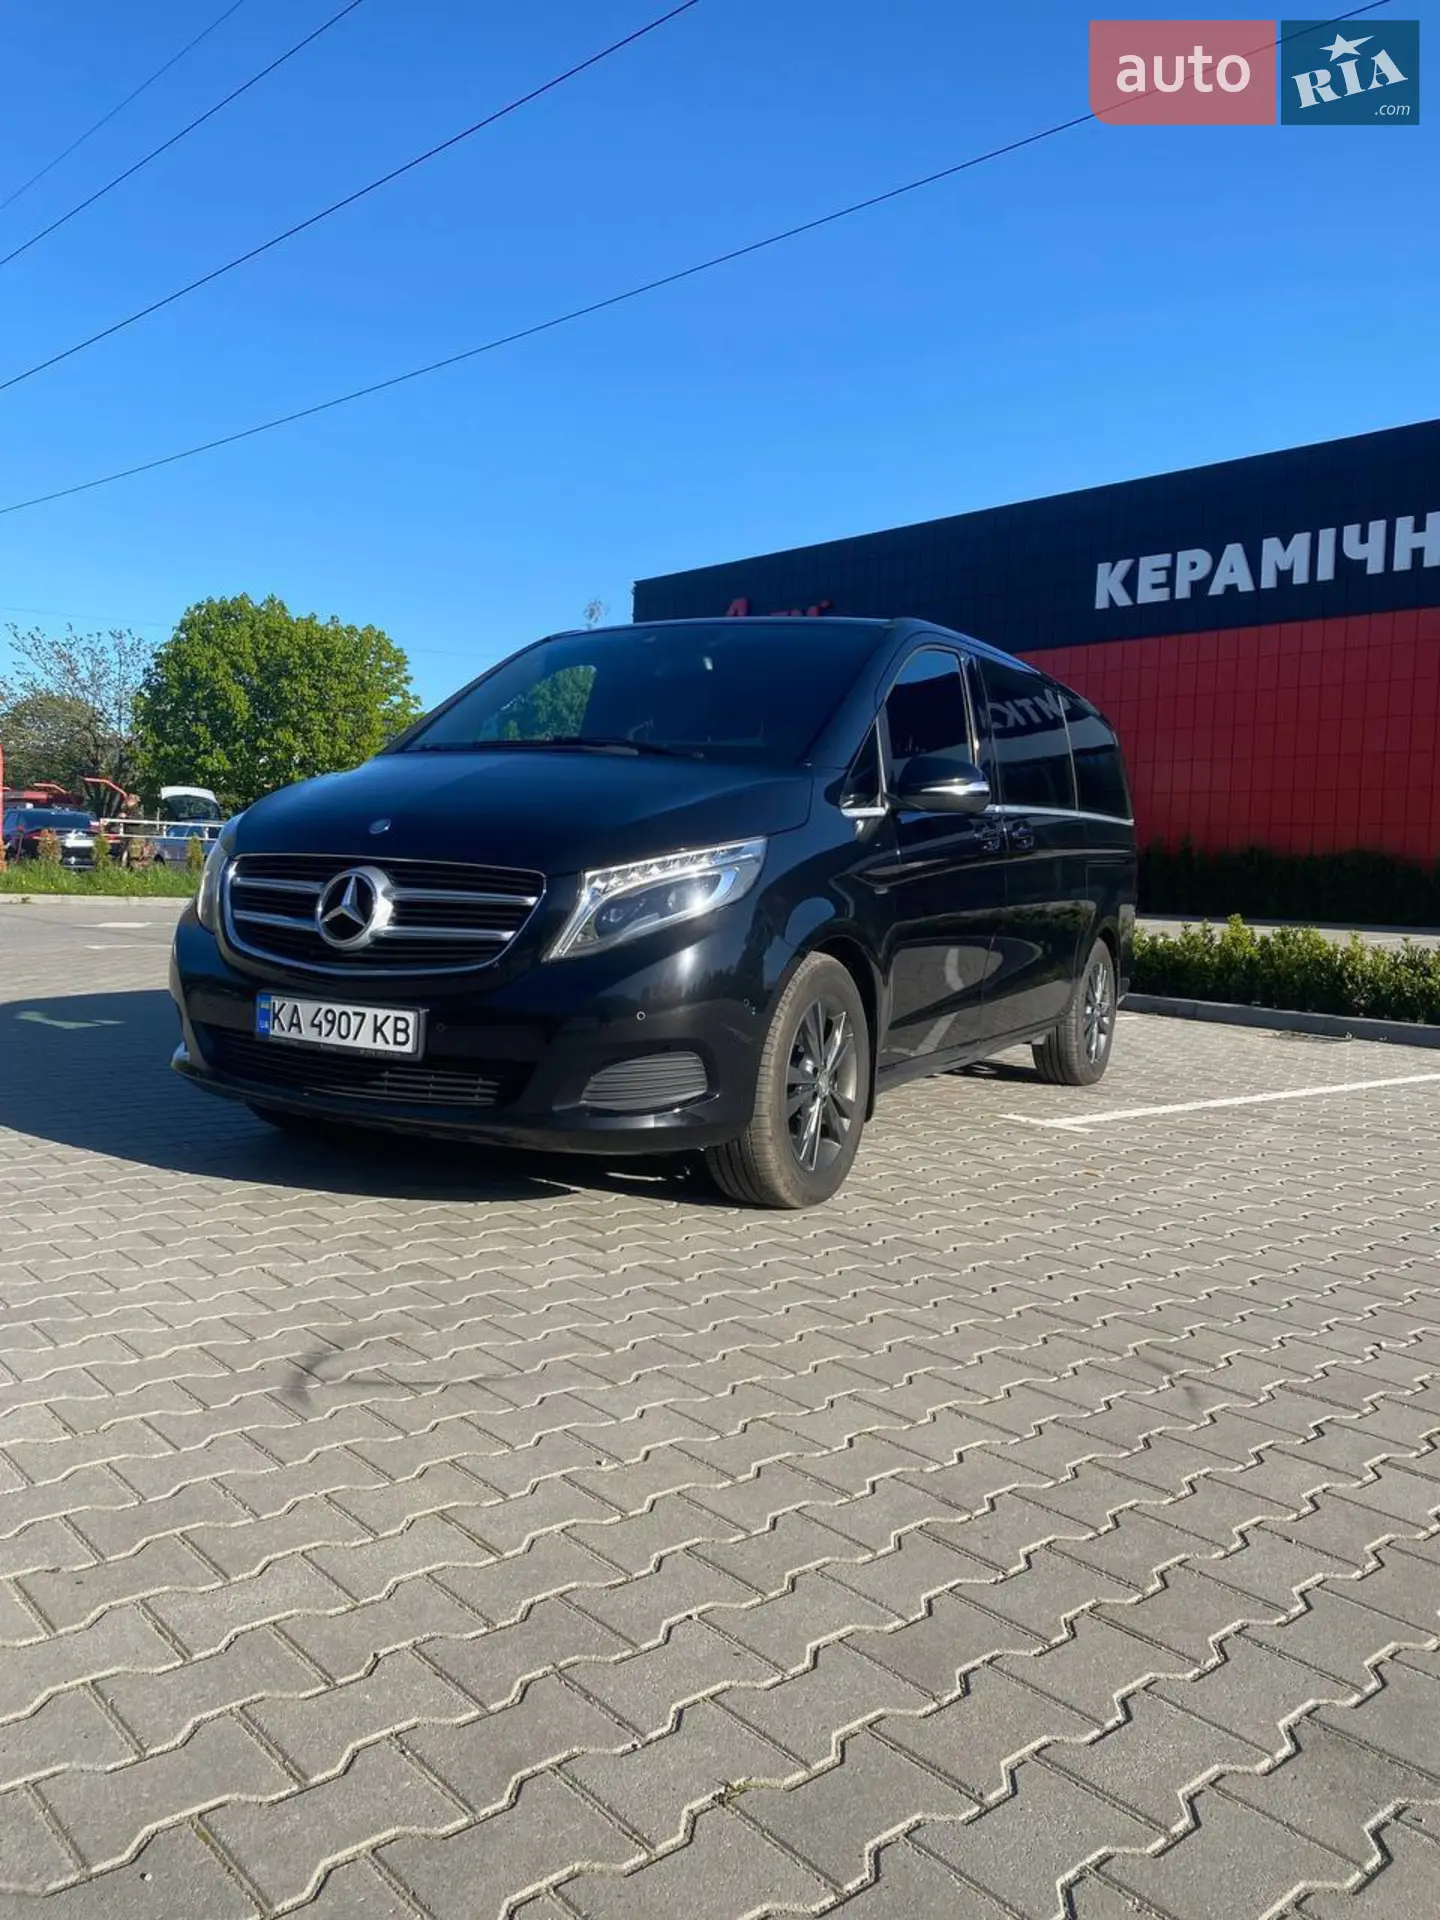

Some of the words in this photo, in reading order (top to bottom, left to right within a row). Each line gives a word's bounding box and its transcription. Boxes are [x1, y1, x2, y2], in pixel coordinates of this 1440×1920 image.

[1094, 511, 1440, 610] КЕРАМІЧН
[271, 1001, 303, 1034] KA
[310, 1007, 367, 1041] 4907
[371, 1013, 411, 1046] KB
